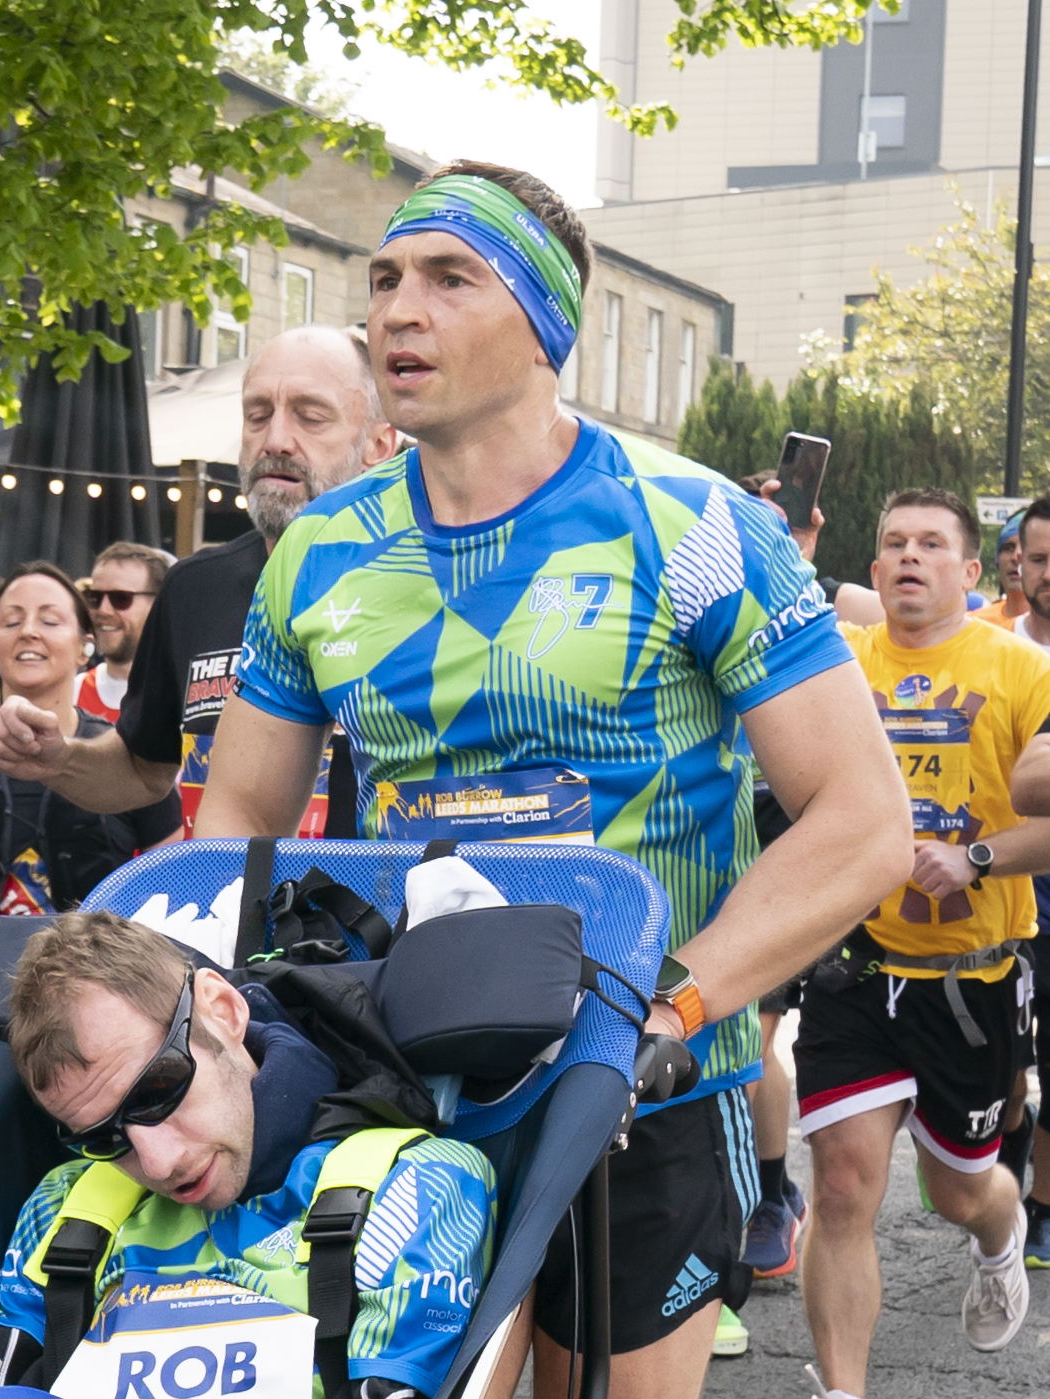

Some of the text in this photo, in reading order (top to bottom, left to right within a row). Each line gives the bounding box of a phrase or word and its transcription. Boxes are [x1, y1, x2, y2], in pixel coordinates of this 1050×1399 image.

[319, 640, 359, 658] OXEN
[191, 655, 230, 682] THE
[435, 792, 454, 804] ROB
[436, 795, 548, 815] LEEDS MARATHON
[502, 809, 551, 825] Clarion
[939, 818, 965, 829] 1174
[661, 1271, 719, 1317] adidas
